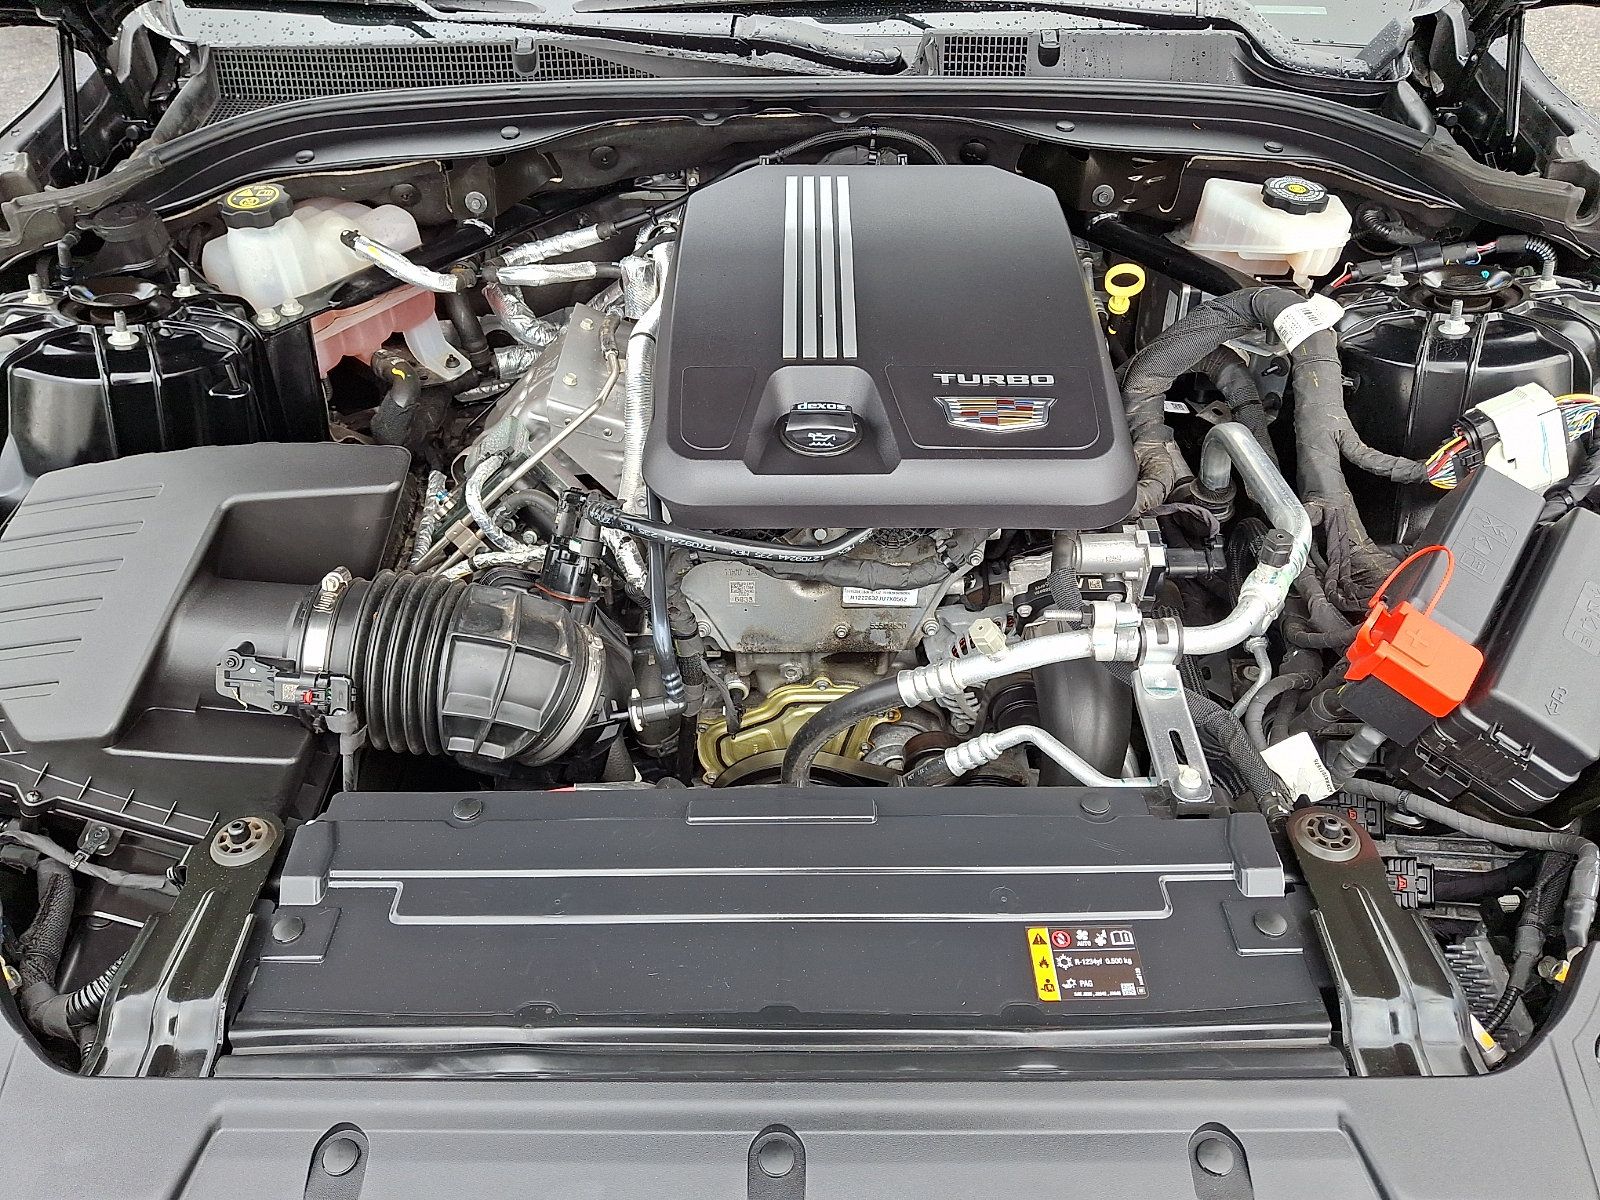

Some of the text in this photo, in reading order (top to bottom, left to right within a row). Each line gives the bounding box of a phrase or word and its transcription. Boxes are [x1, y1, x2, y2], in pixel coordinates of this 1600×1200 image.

[932, 373, 1055, 386] TURBO
[797, 402, 847, 410] dexos
[638, 528, 659, 538] 235
[664, 535, 718, 552] 12709244
[730, 549, 750, 557] MEX
[838, 544, 855, 555] MEX
[754, 551, 773, 559] 235
[778, 554, 825, 562] 12709244
[1105, 957, 1123, 965] 0.500
[1123, 957, 1133, 966] kg
[1079, 979, 1094, 988] PAG
